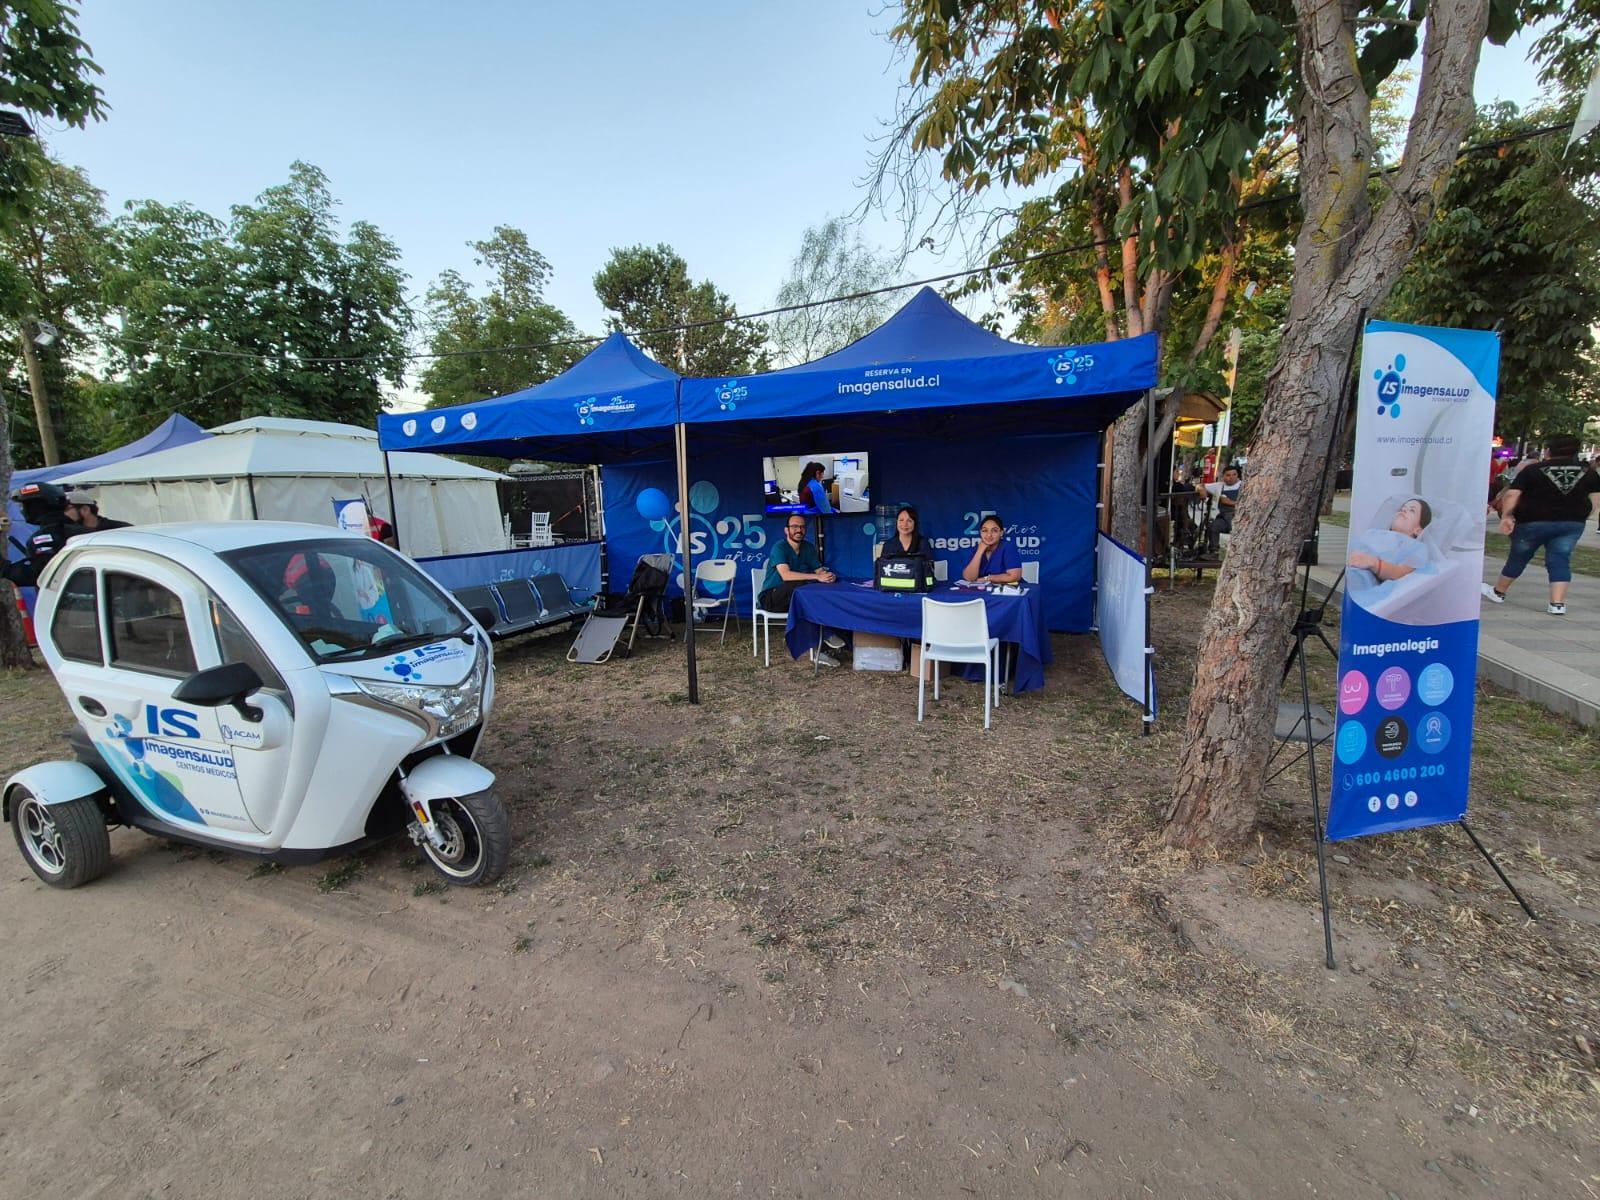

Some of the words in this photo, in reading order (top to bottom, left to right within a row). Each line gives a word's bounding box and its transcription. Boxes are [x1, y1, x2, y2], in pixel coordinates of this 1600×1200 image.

[1076, 354, 1094, 368] 25
[865, 369, 899, 377] RESERVA
[838, 375, 940, 395] imagensalud.cl
[1401, 383, 1470, 398] imagenSALUD
[722, 515, 767, 549] 25
[1352, 637, 1439, 657] Imagenología
[146, 704, 201, 739] IS
[233, 729, 261, 740] ACAM
[144, 741, 234, 768] imagenSALUD
[1356, 772, 1380, 786] 600
[1420, 764, 1445, 778] 200
